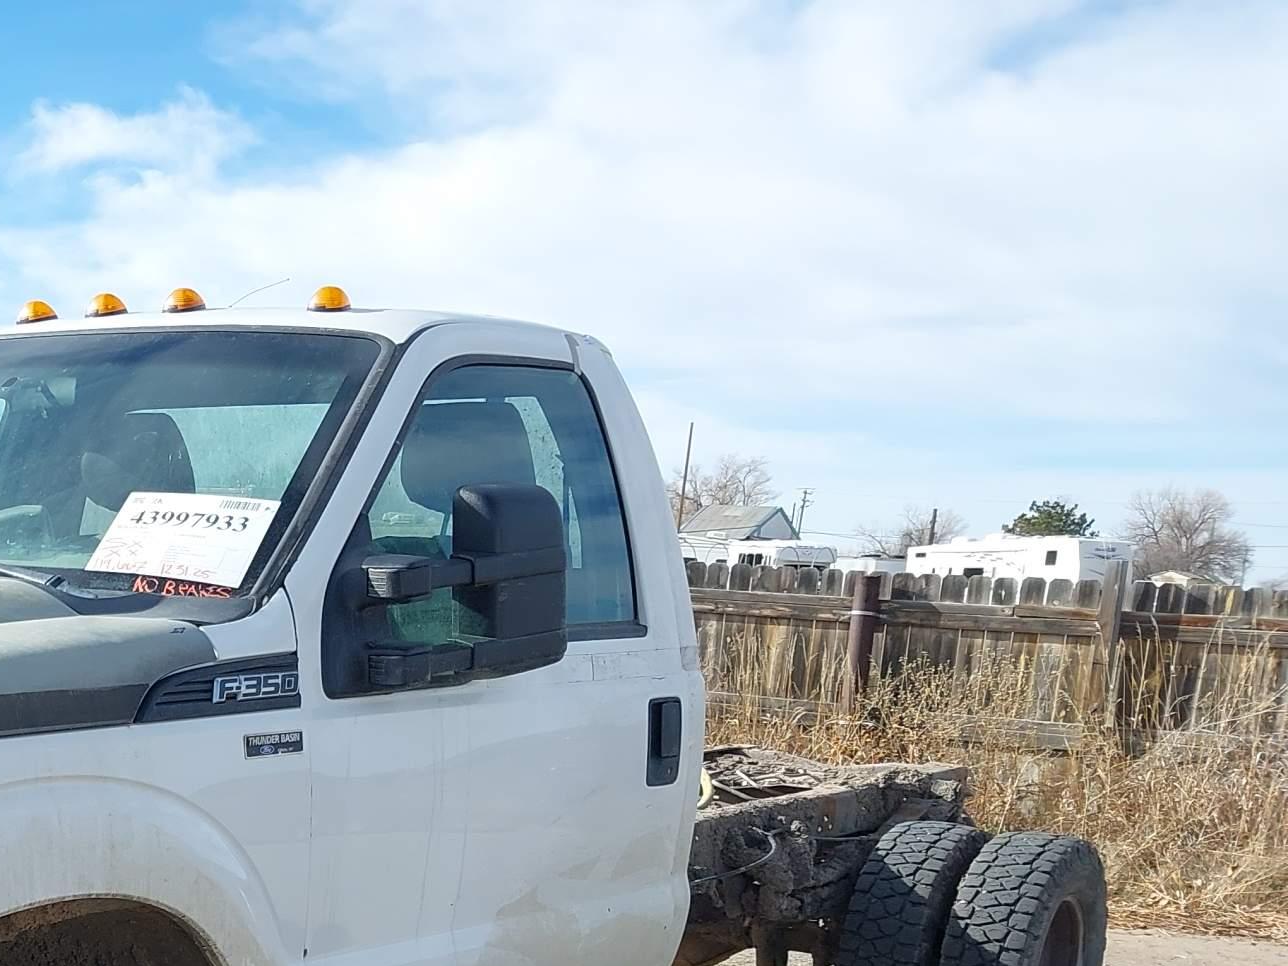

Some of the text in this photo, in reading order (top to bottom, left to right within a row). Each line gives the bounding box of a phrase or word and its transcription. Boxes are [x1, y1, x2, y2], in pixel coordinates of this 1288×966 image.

[130, 510, 251, 533] 43997933
[132, 576, 159, 593] NO
[212, 672, 300, 704] F-350
[248, 733, 301, 747] THUNDER BASIN
